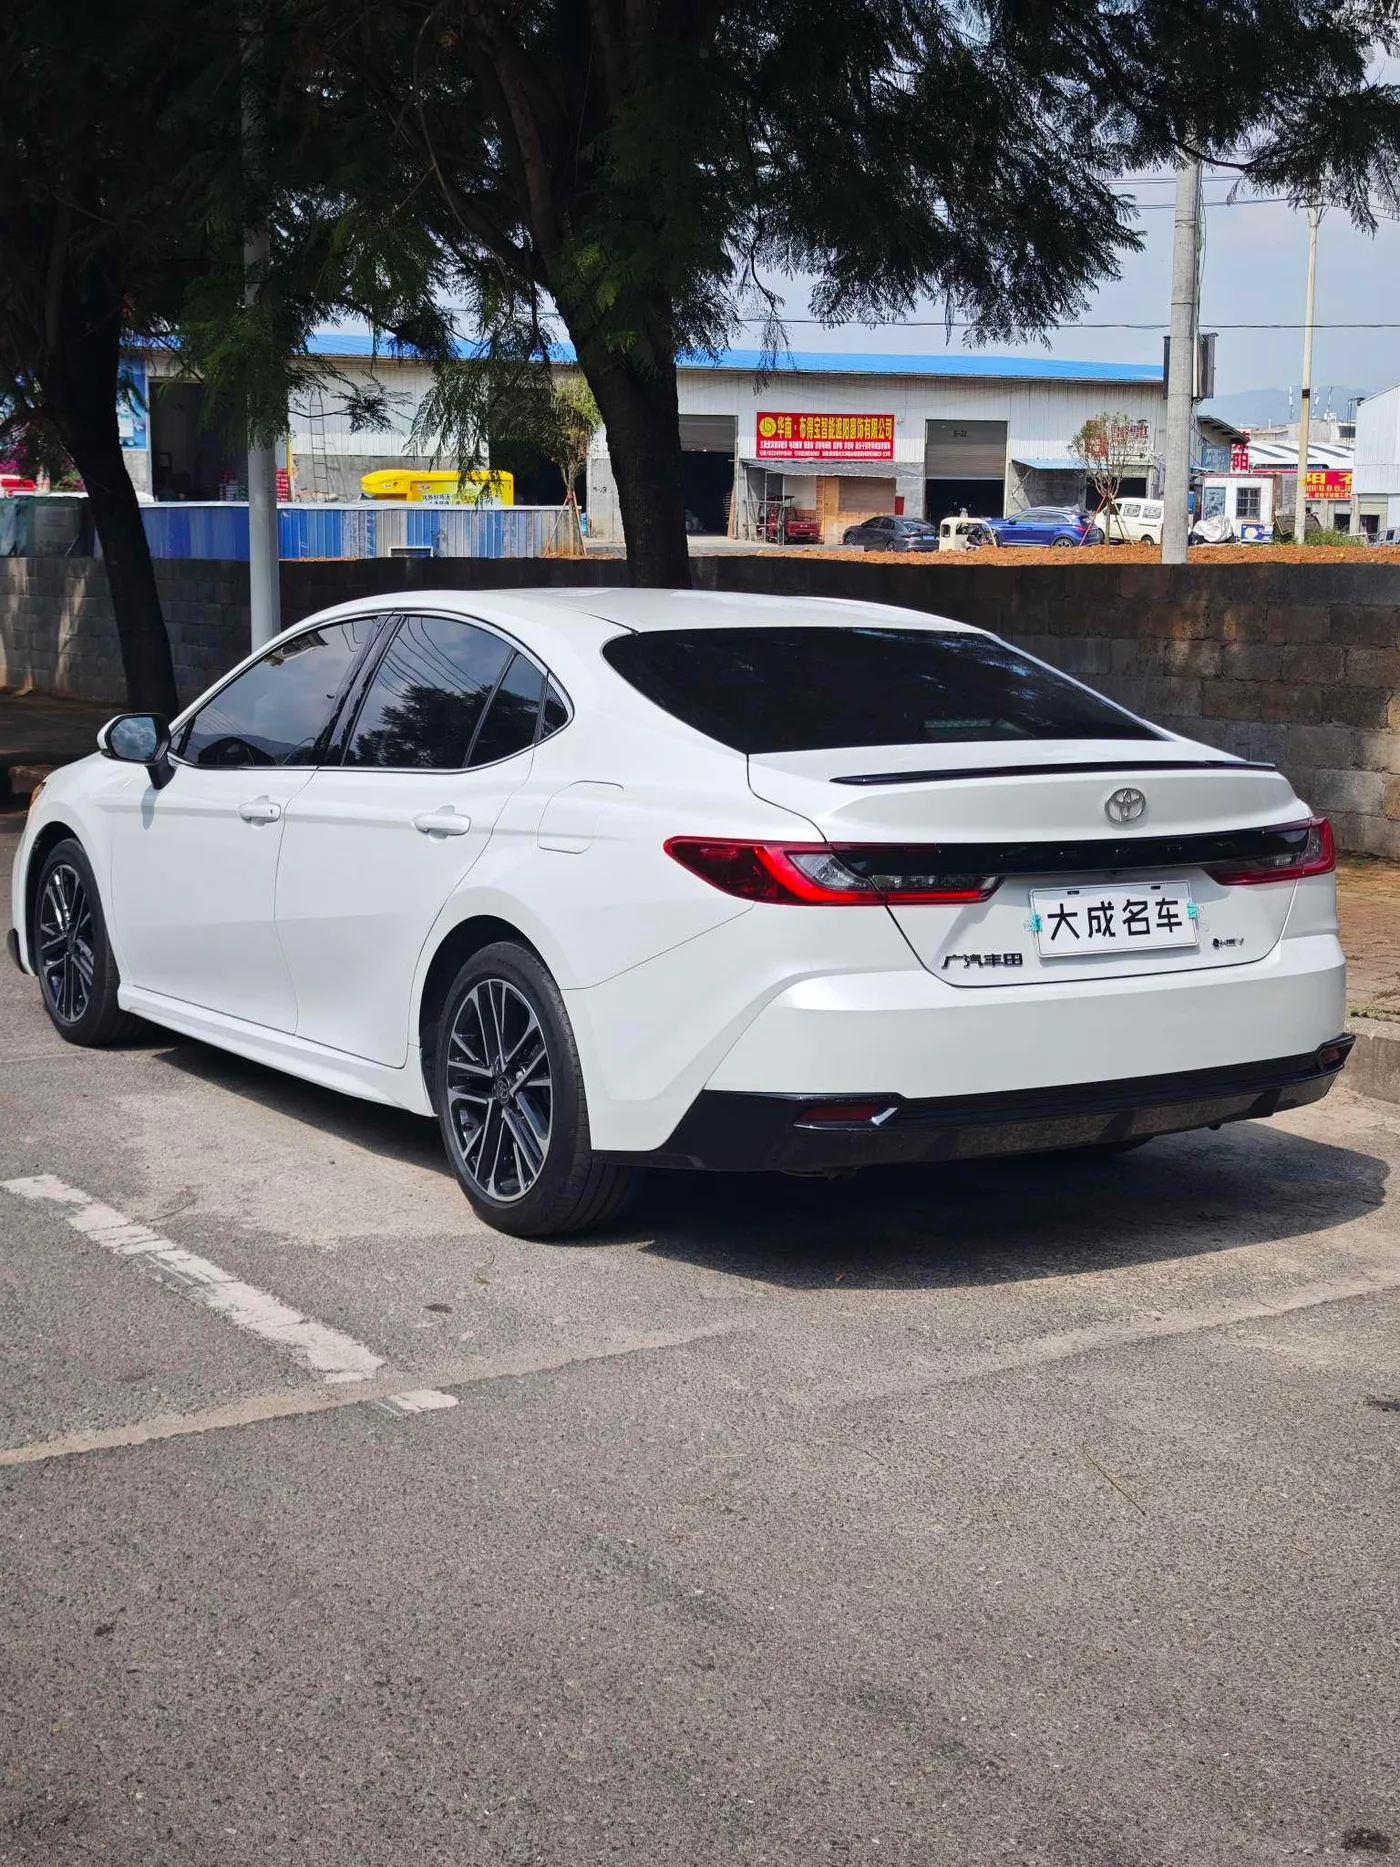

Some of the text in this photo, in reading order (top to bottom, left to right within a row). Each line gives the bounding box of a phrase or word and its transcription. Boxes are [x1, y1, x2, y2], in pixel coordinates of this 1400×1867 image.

[1047, 897, 1183, 941] 大成名车
[941, 953, 1023, 970] 广汽丰田
